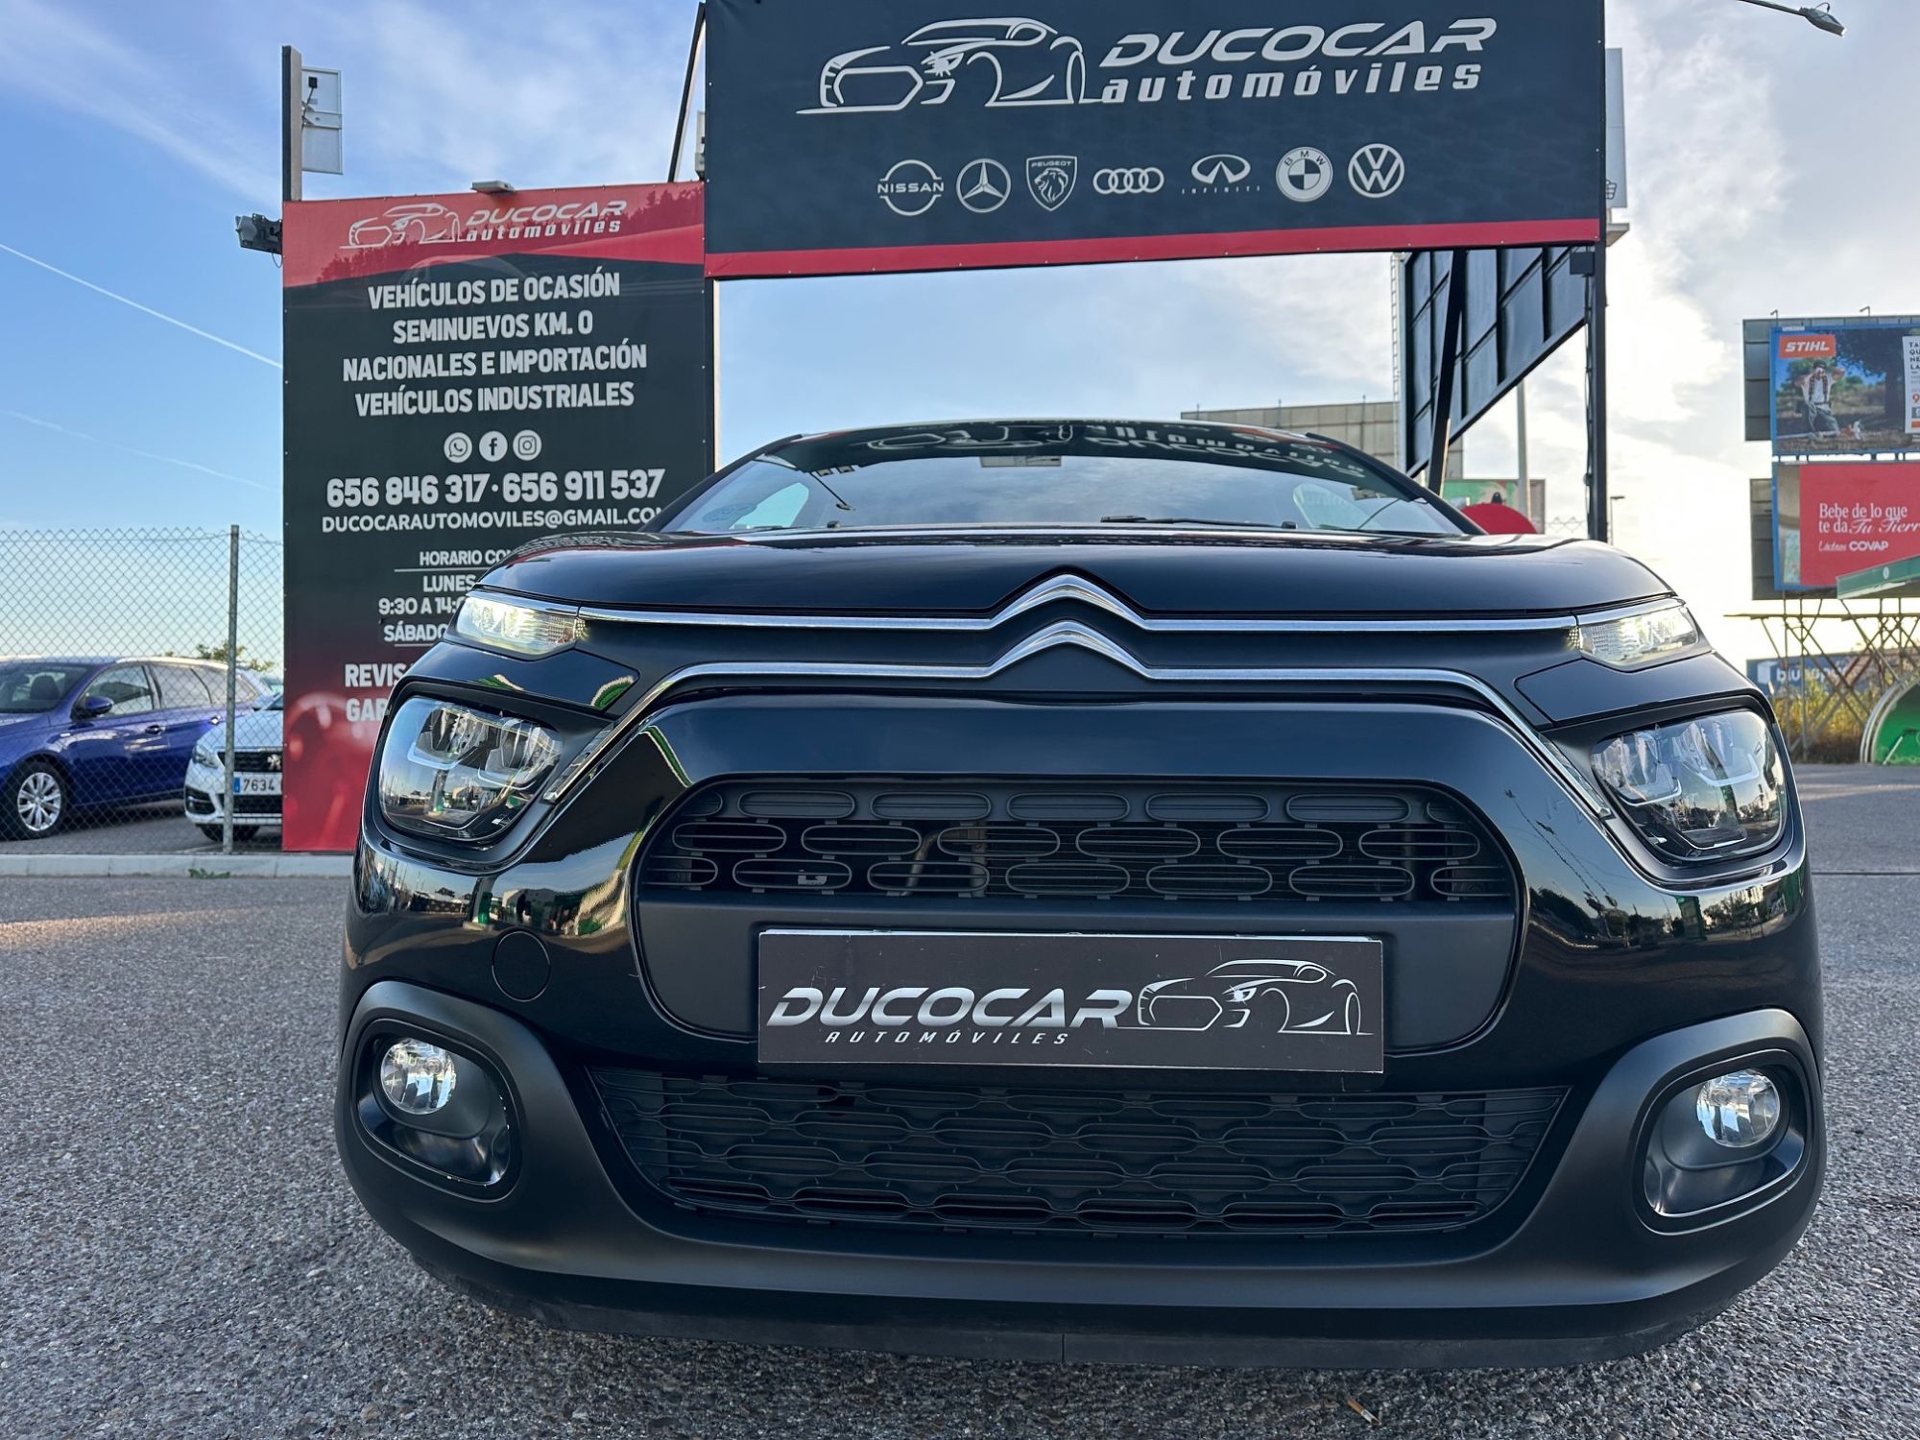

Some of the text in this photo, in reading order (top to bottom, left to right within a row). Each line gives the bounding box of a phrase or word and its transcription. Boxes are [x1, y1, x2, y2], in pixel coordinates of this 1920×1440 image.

[1100, 18, 1497, 68] DUCOCAR
[1102, 61, 1480, 103] automóviles
[1031, 160, 1072, 168] PEUGEOT
[1284, 149, 1327, 167] BMW
[877, 182, 945, 194] NISSAN
[1181, 185, 1261, 195] INFINITI
[466, 200, 627, 226] DUCOCAR
[368, 266, 620, 310] VEHÍCULOS DE OCASIÓN
[392, 313, 530, 344] SEMINUEVOS
[534, 311, 573, 337] KM.
[1785, 341, 1830, 353] STIHL
[343, 338, 647, 382] NACIONALES E IMPORTACIÓN
[355, 381, 635, 417] VEHÍCULOS INDUSTRIALES
[326, 477, 380, 508] 656
[385, 475, 439, 507] 846
[564, 470, 605, 500] 911
[611, 469, 666, 499] 537
[322, 507, 661, 533] DUCOCARAUTOMOVILES@GMAIL.CO
[1819, 502, 1908, 521] Bebe de lo que
[1819, 520, 1831, 533] te
[1833, 518, 1848, 533] da
[1848, 540, 1889, 551] COVAP
[419, 549, 511, 566] HORARIO CO
[423, 574, 477, 593] LUNES
[378, 597, 418, 615] 9:30
[421, 597, 432, 614] A
[345, 662, 413, 687] REVIS
[243, 779, 275, 791] 7634
[766, 987, 1134, 1029] DUCOCAR
[825, 1028, 1069, 1046] AUTOMÓVILES
